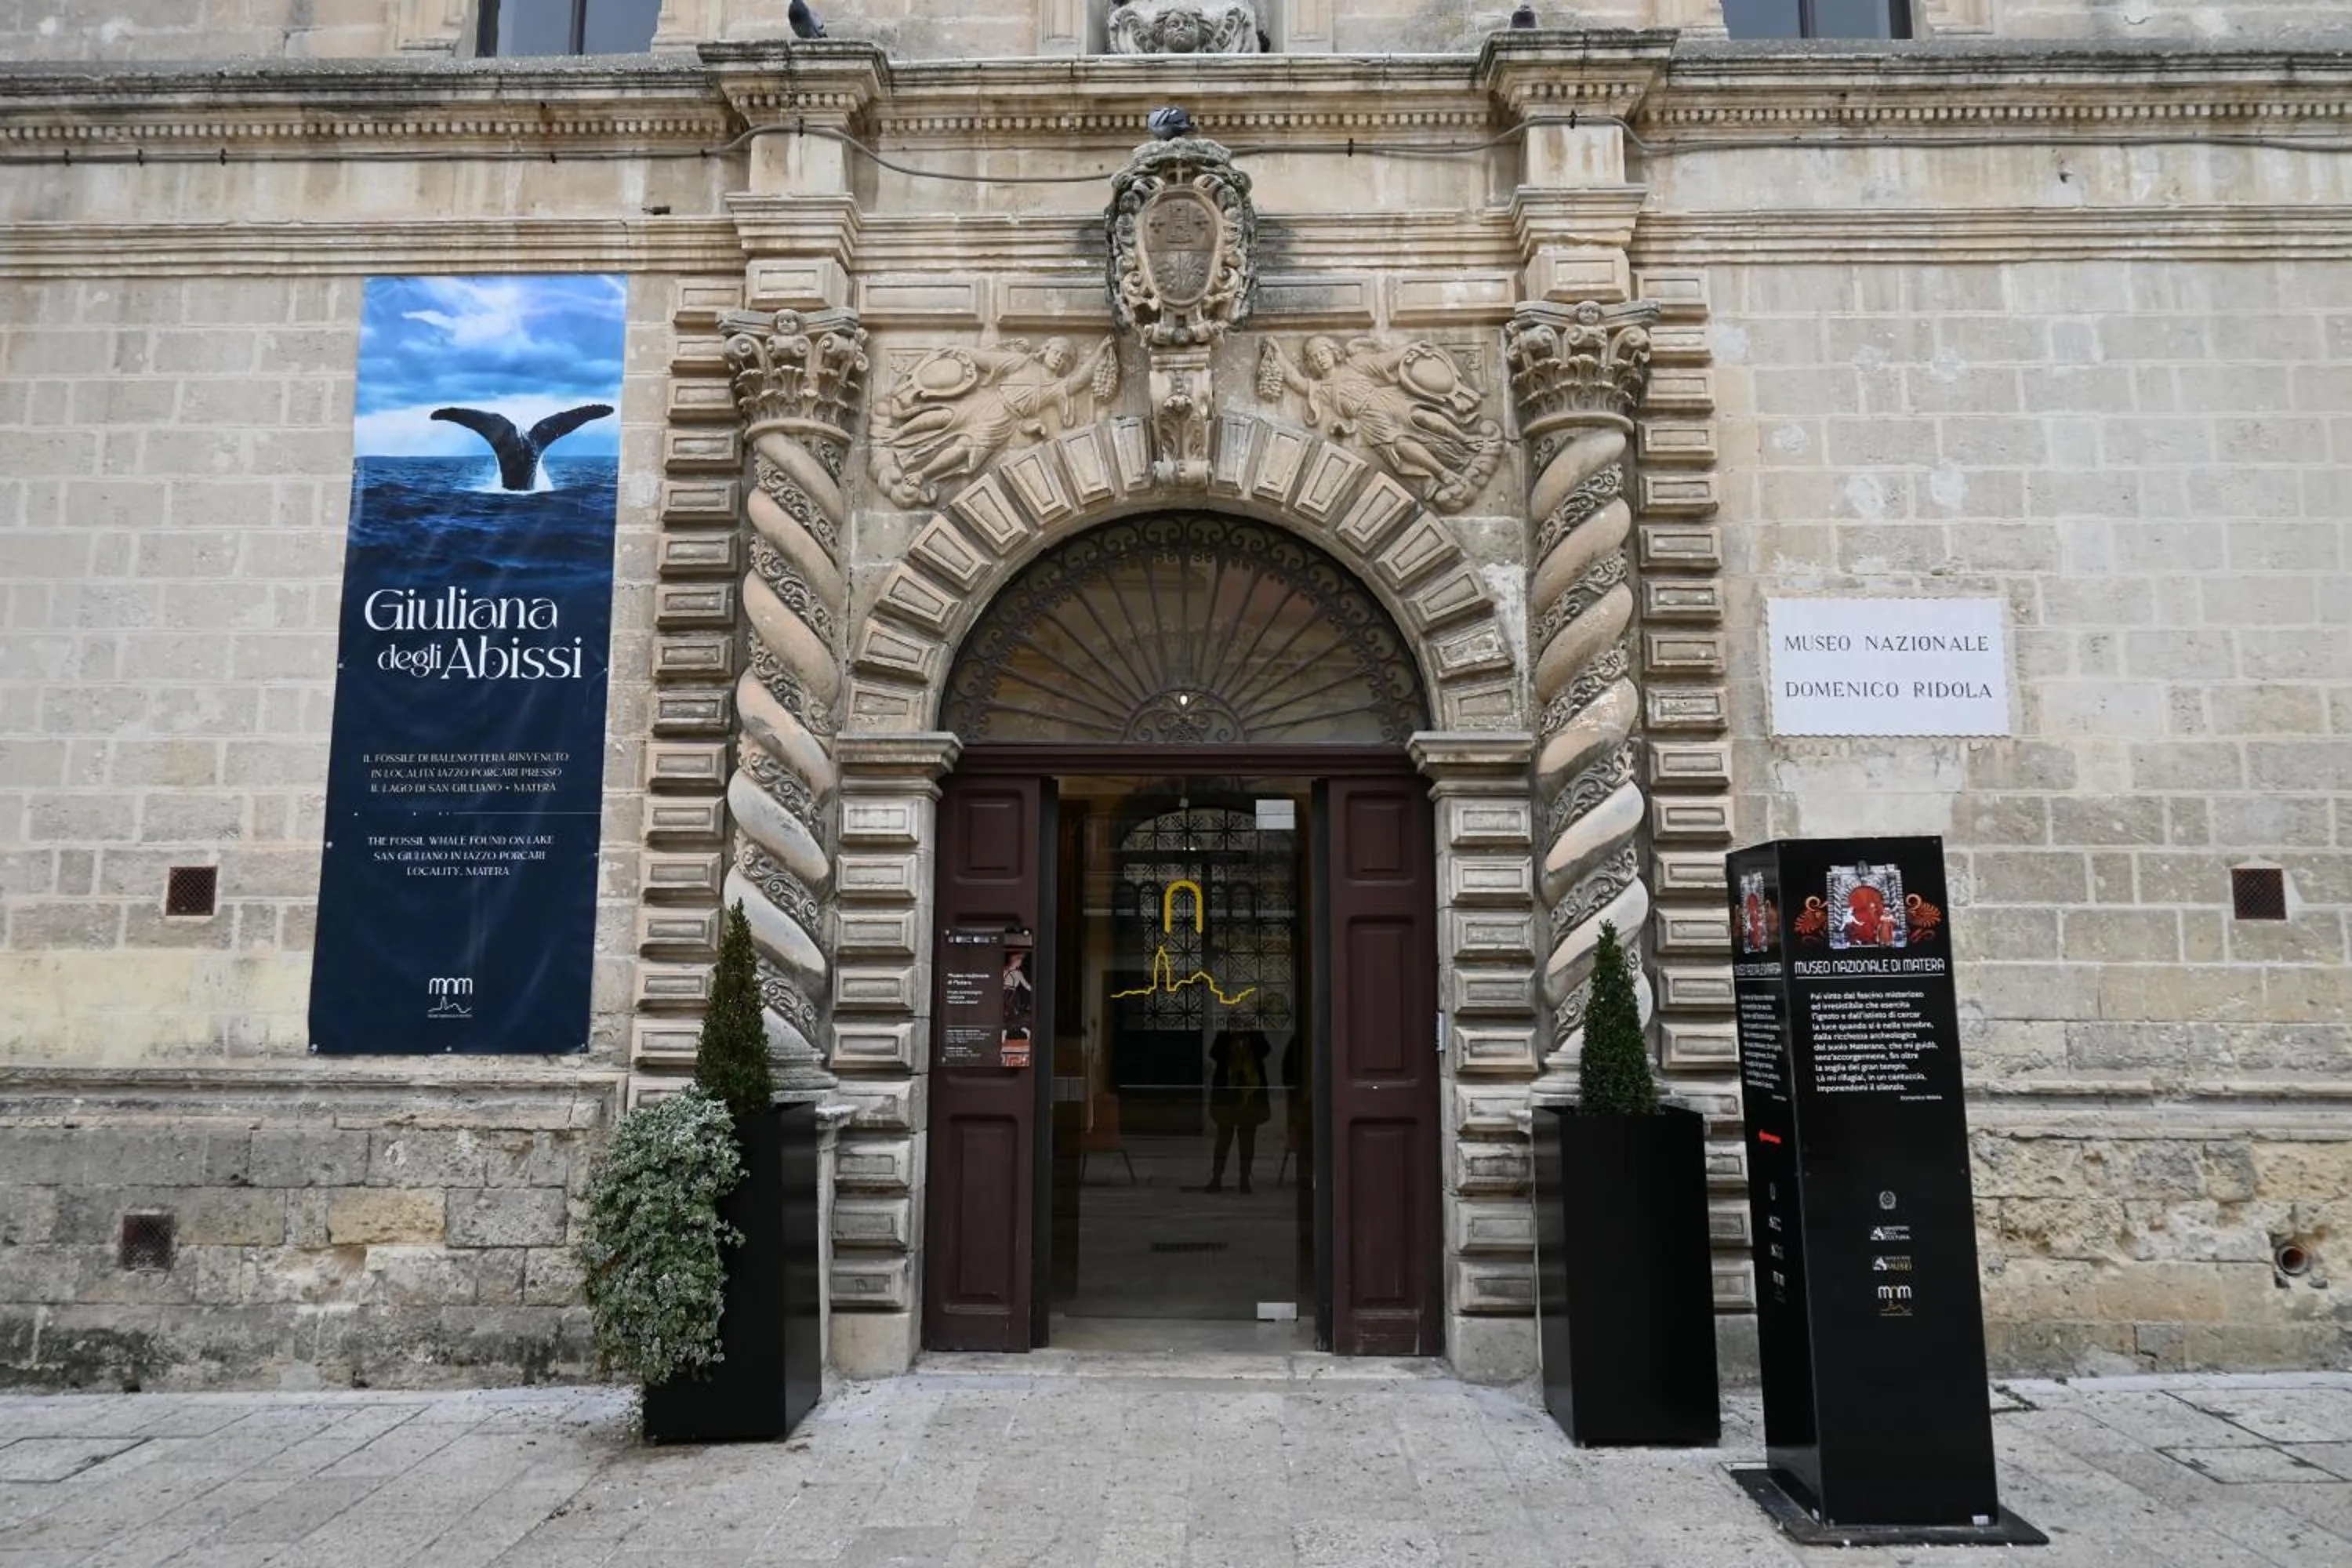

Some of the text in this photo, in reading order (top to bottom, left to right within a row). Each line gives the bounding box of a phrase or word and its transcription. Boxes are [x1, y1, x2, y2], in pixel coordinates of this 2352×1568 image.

[365, 586, 557, 631] Giuliana
[1784, 635, 1989, 652] MUSEO NAZIONALE
[377, 635, 582, 680] degli Abissi
[1785, 681, 1993, 699] DOMENICO RIDOLA
[374, 753, 415, 763] FOSSILE
[418, 753, 429, 763] DI
[430, 753, 505, 763] BALENOTTERA
[508, 752, 570, 762] RINVENUTO
[371, 769, 382, 779] IN
[471, 768, 518, 778] PORCARI
[521, 768, 562, 777] PRESSO
[382, 783, 412, 793] LAGO
[415, 783, 426, 793] DI
[428, 783, 449, 793] SAN
[452, 783, 503, 793] GIULIANO
[514, 783, 557, 793] MATERA
[368, 834, 554, 846] THE FOSSIL WHALE FOUND ON LAKE
[373, 851, 394, 861] SAN
[397, 851, 448, 861] GIULIANO
[450, 851, 462, 861] IN
[499, 851, 546, 860] PORCARI
[466, 866, 510, 877] MATERA
[1795, 960, 1831, 975] MUSEO
[1832, 959, 1890, 973] NAZIONALE
[1891, 959, 1901, 972] DI
[1904, 958, 1944, 972] MATERA
